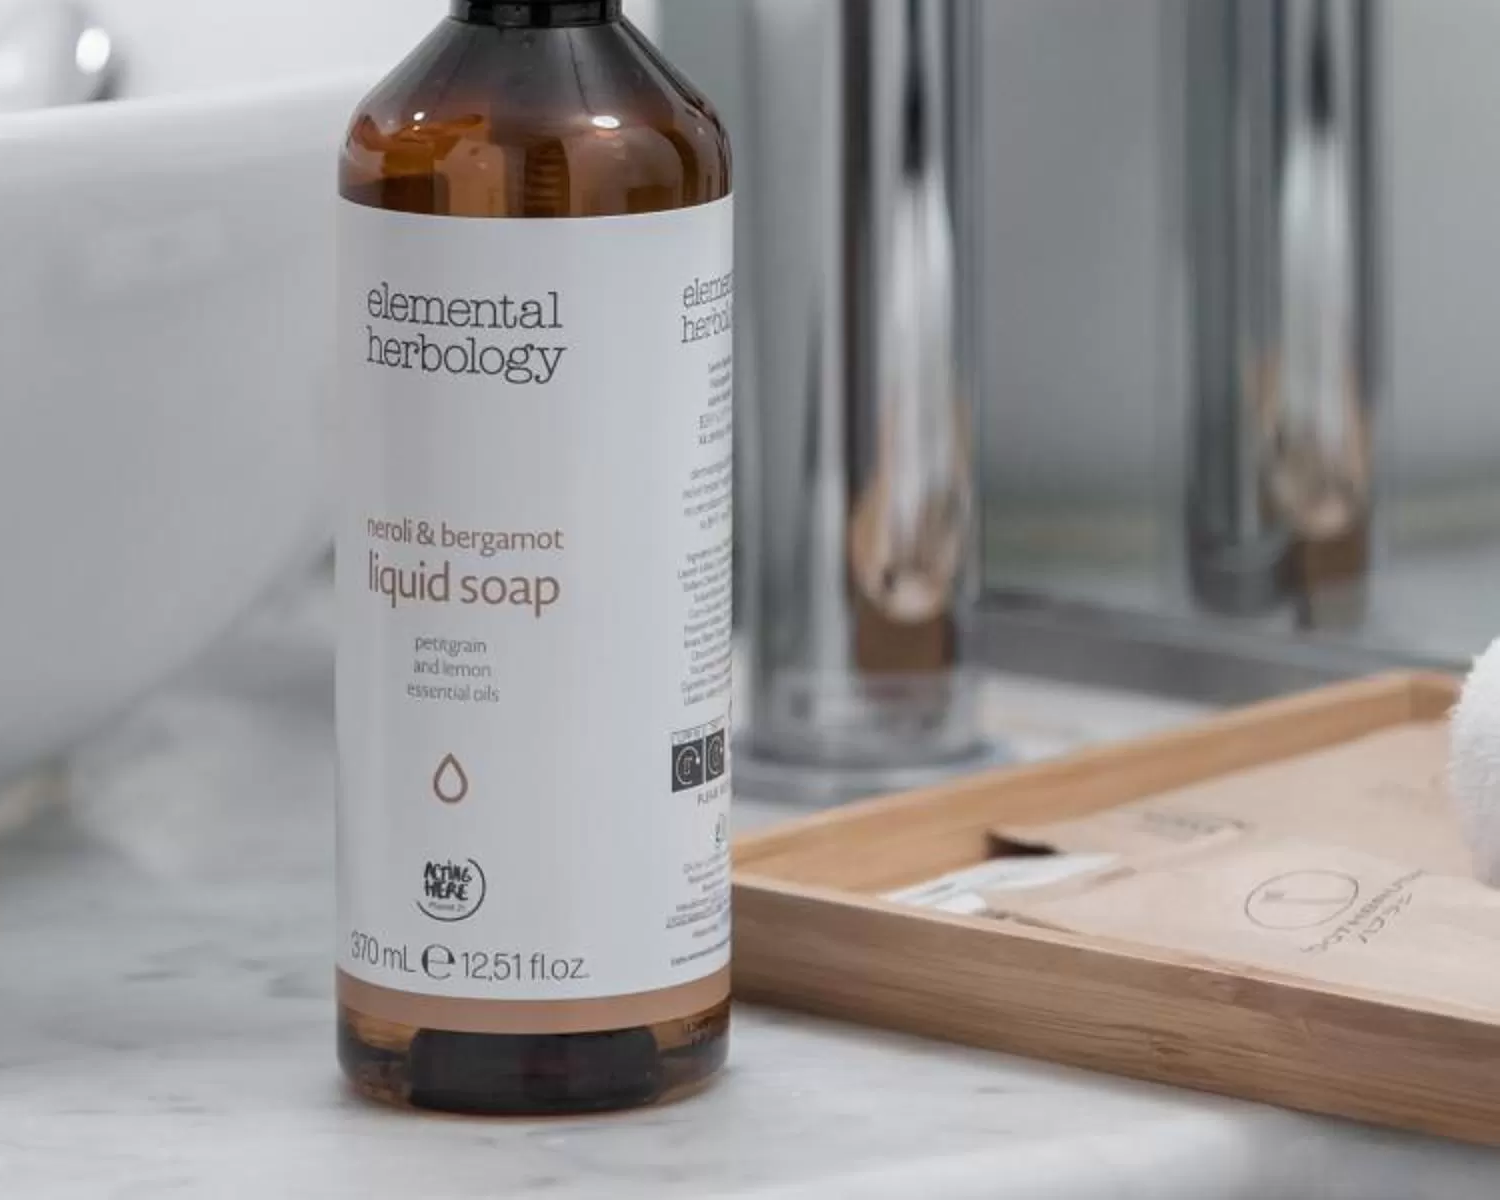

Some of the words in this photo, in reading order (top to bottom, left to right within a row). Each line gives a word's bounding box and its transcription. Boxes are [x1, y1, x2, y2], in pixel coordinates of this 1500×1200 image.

[366, 282, 564, 329] elemental
[682, 272, 733, 307] eleme
[366, 324, 567, 384] herbology
[367, 517, 412, 544] neroli
[416, 521, 436, 546] &
[441, 523, 564, 558] bergamot
[368, 550, 451, 608] liquid
[460, 574, 560, 618] soap
[415, 636, 487, 657] petitgrain
[413, 658, 439, 675] and
[442, 660, 492, 678] lemon
[407, 683, 471, 701] essential
[473, 684, 500, 703] oils
[424, 879, 469, 901] HERE
[351, 929, 379, 965] 370
[383, 944, 417, 973] mL
[461, 950, 521, 983] 12,51
